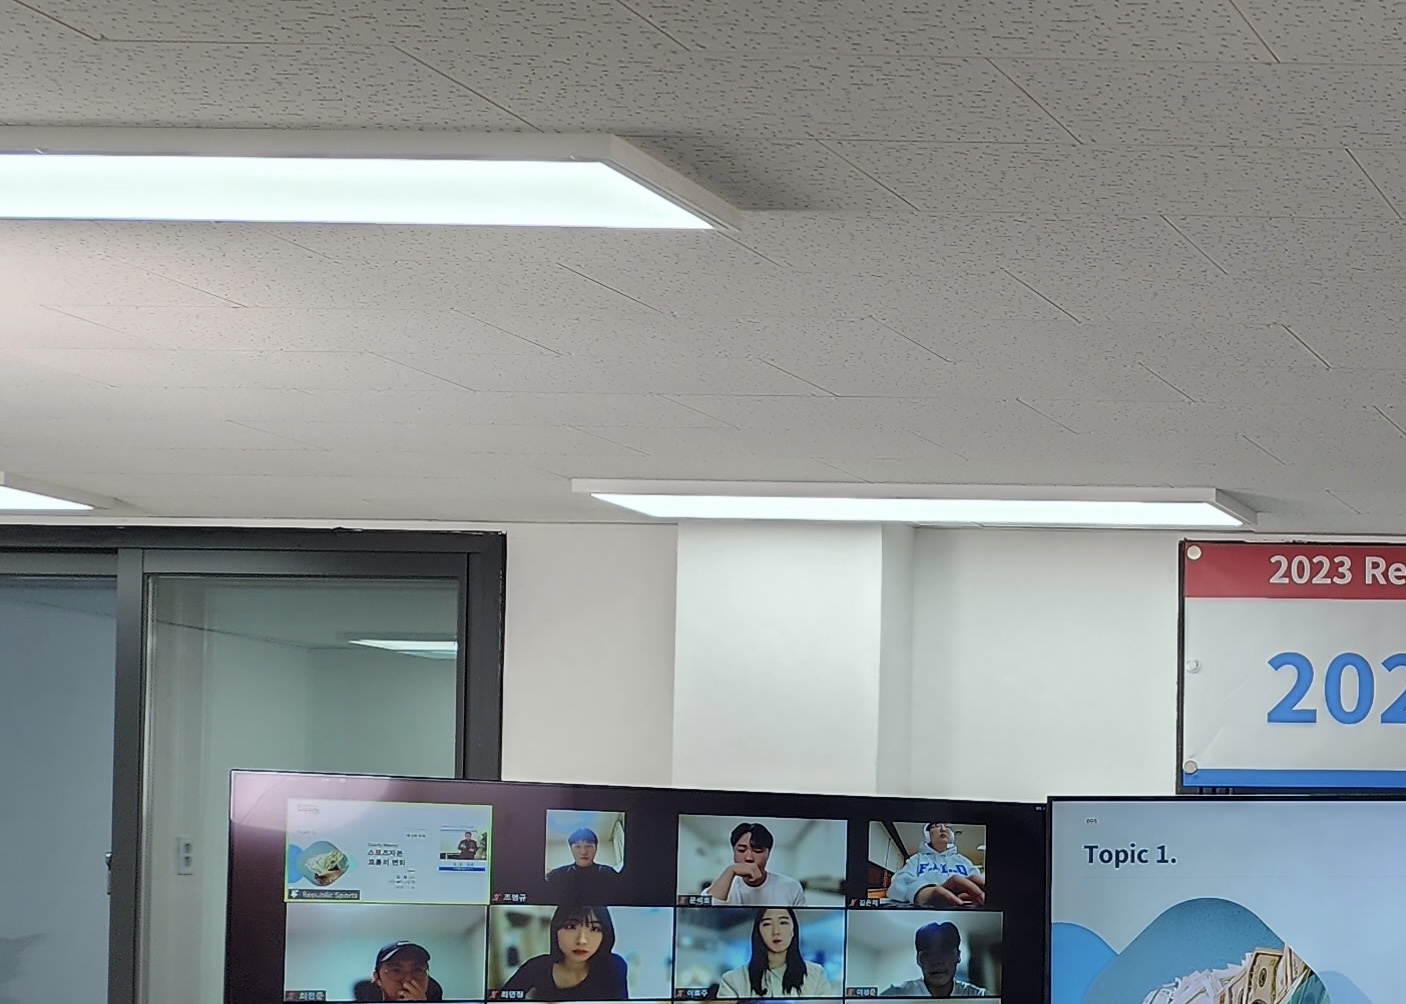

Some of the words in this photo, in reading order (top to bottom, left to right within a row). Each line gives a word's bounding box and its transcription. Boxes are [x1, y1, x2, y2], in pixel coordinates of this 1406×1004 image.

[1269, 555, 1353, 584] 2023
[1083, 842, 1149, 868] Topic
[1156, 845, 1177, 864] 1.
